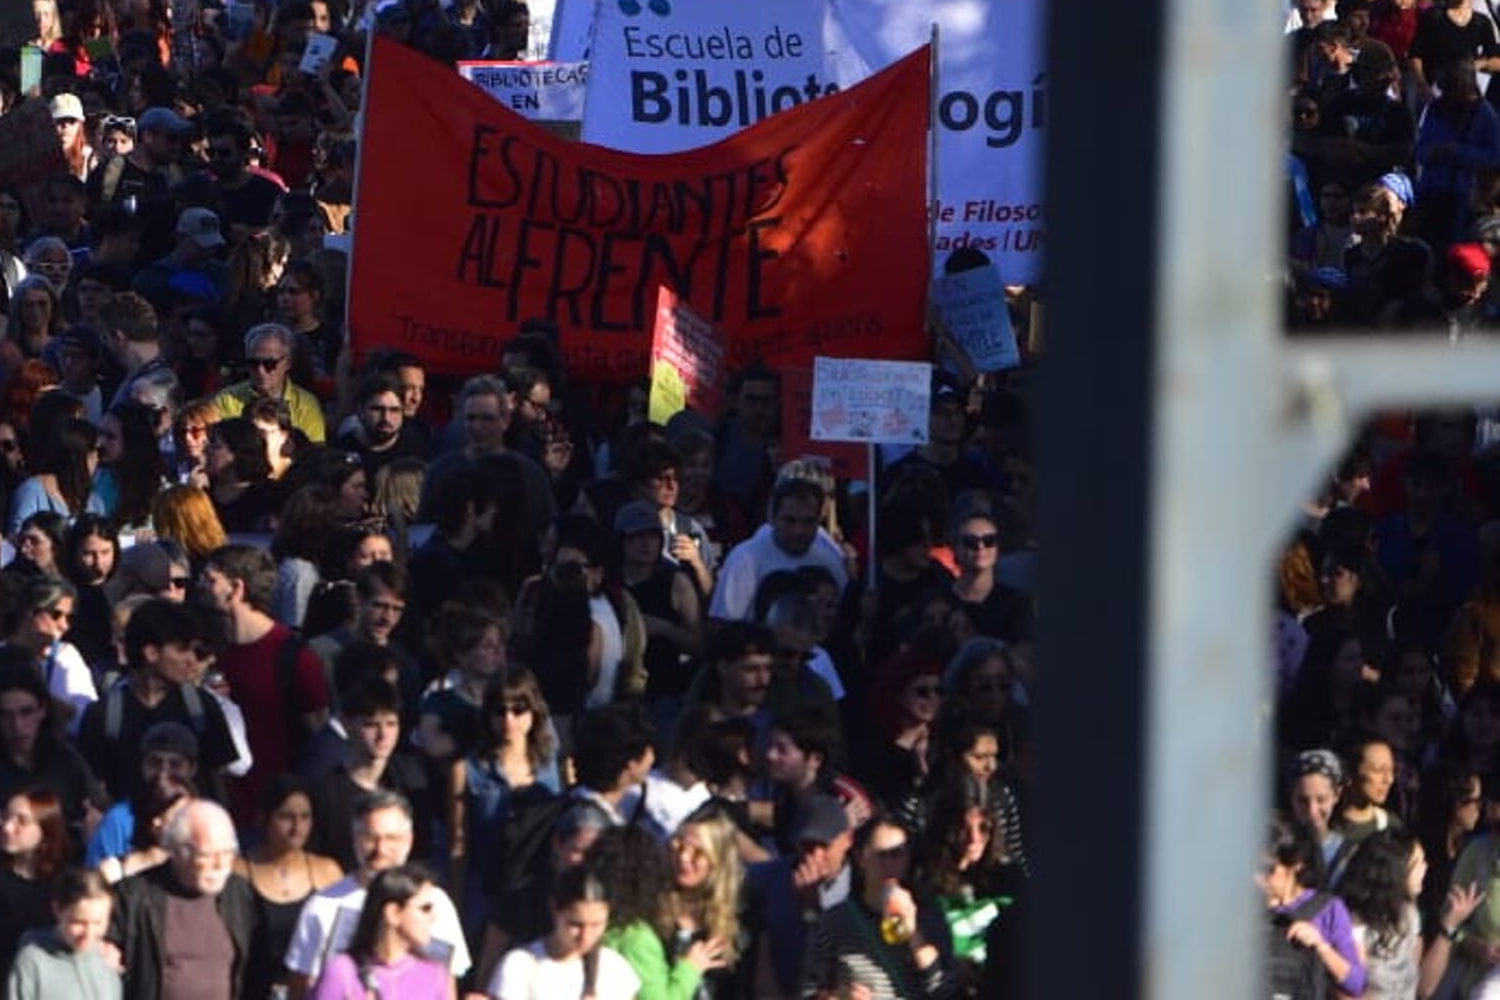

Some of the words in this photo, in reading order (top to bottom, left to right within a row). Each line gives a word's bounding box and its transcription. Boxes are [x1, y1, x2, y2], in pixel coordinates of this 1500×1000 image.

[623, 26, 754, 60] Escuela
[765, 27, 804, 59] de
[512, 91, 540, 109] EN
[458, 214, 505, 290] AL
[506, 216, 783, 332] FRENTE
